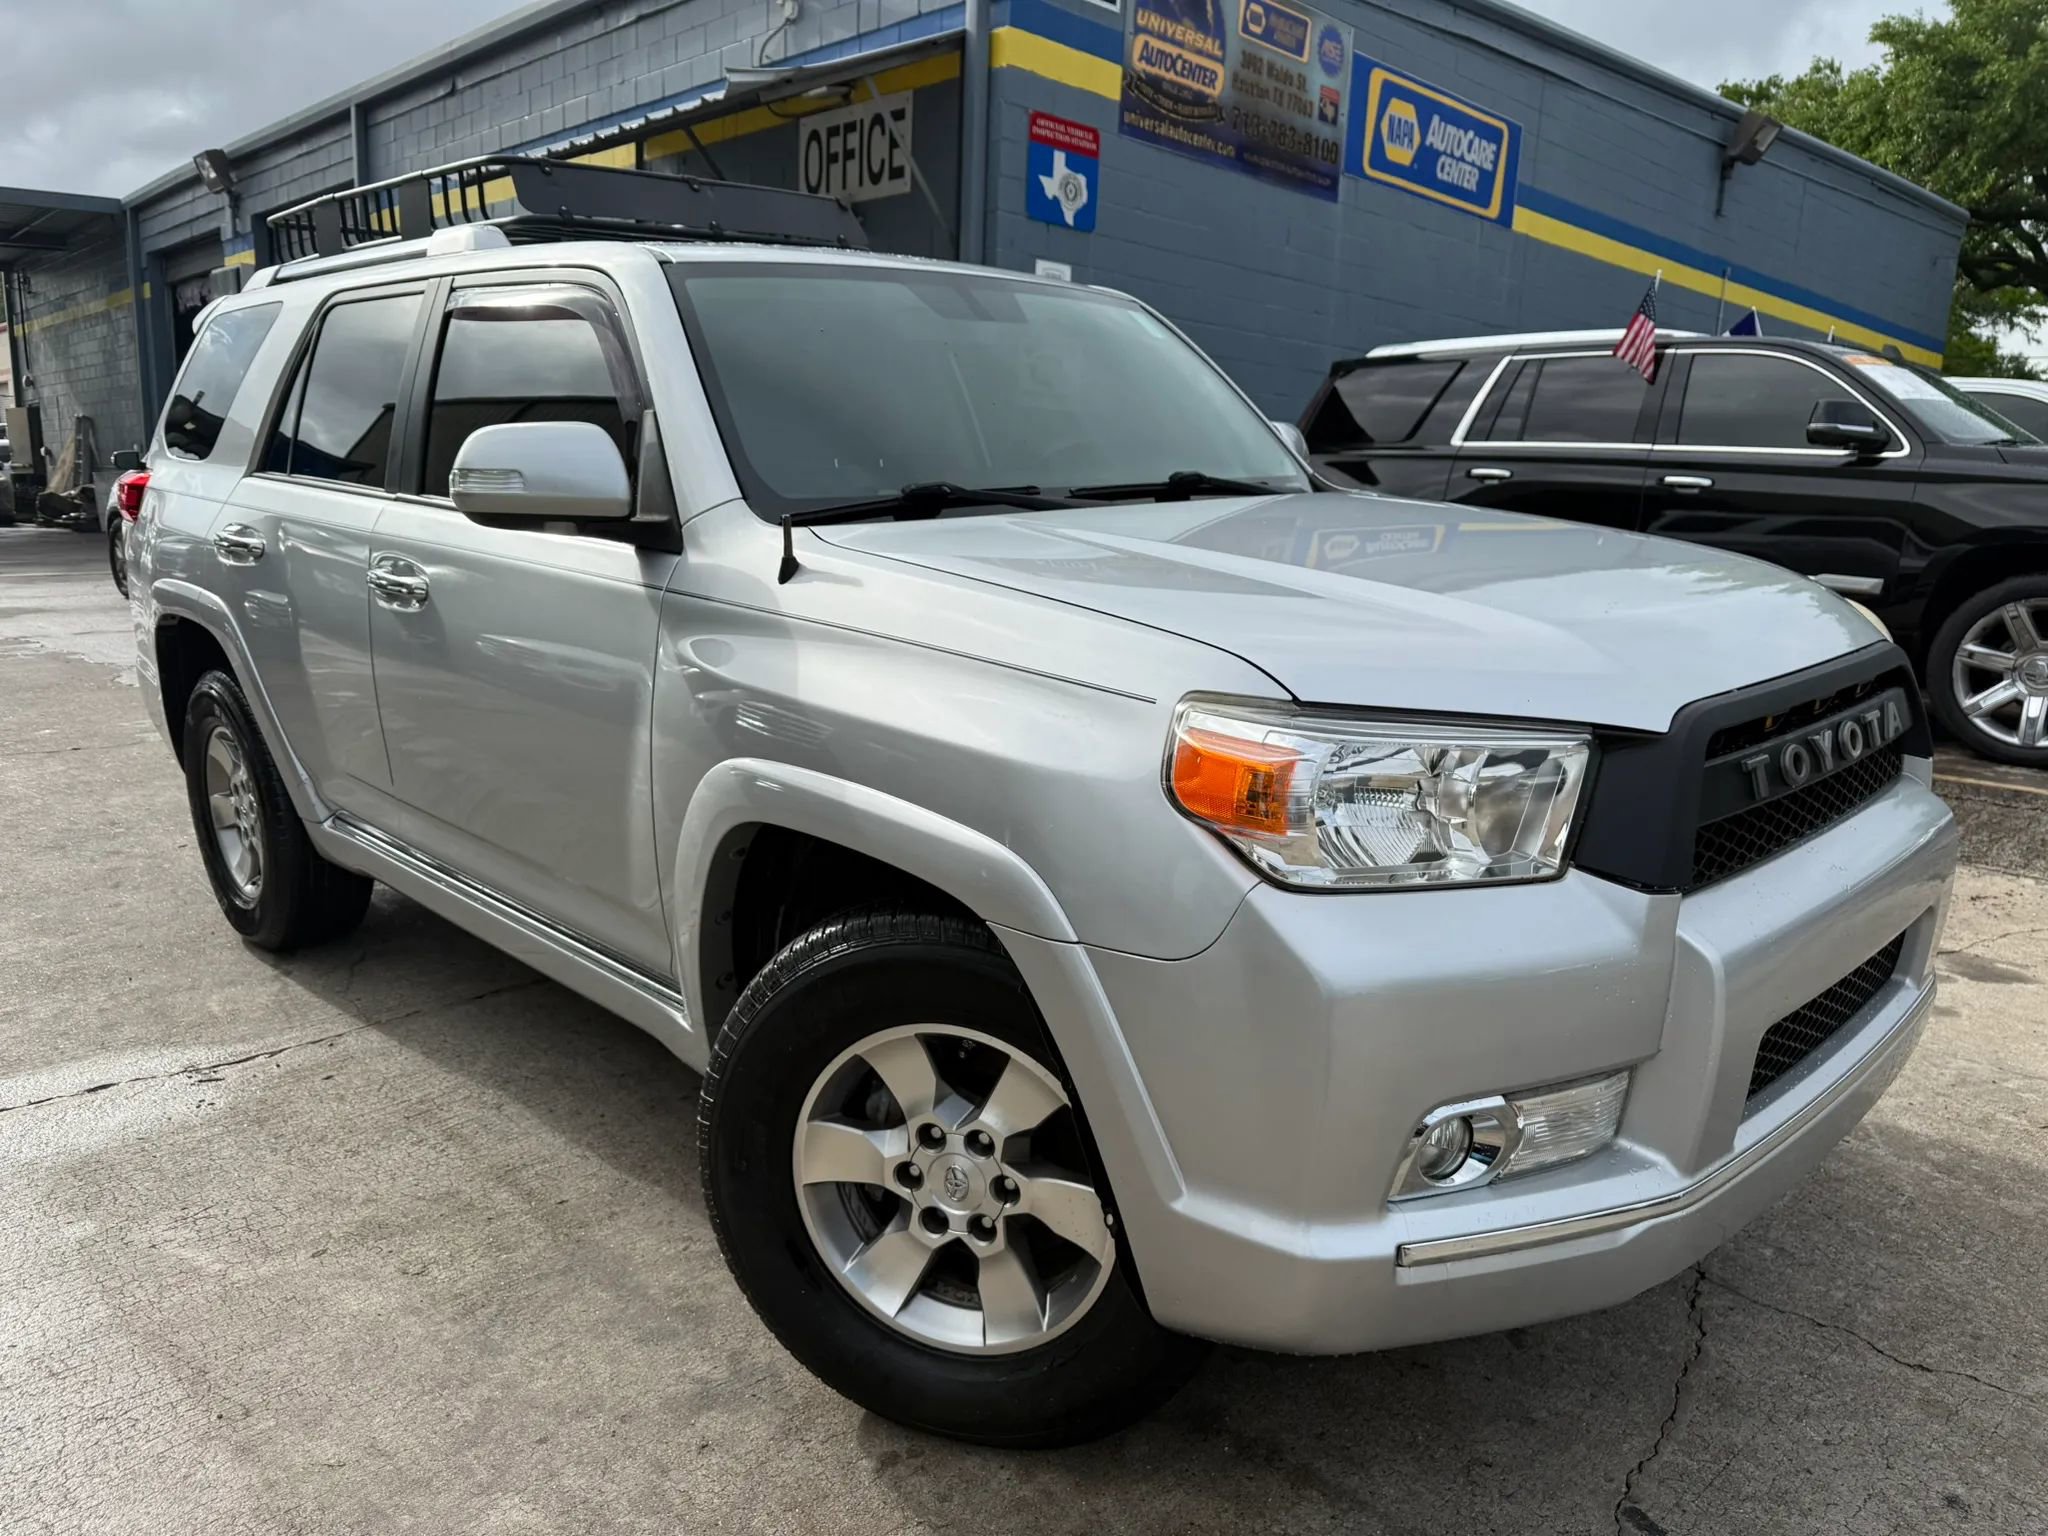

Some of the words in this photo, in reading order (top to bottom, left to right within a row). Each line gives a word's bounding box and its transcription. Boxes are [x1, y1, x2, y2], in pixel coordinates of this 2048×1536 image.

[1137, 10, 1222, 56] UNIVERSAL
[804, 107, 906, 195] OFFICE
[1387, 113, 1415, 152] NAPA
[1436, 154, 1480, 192] CENTER
[1741, 700, 1904, 801] TOYOTA
